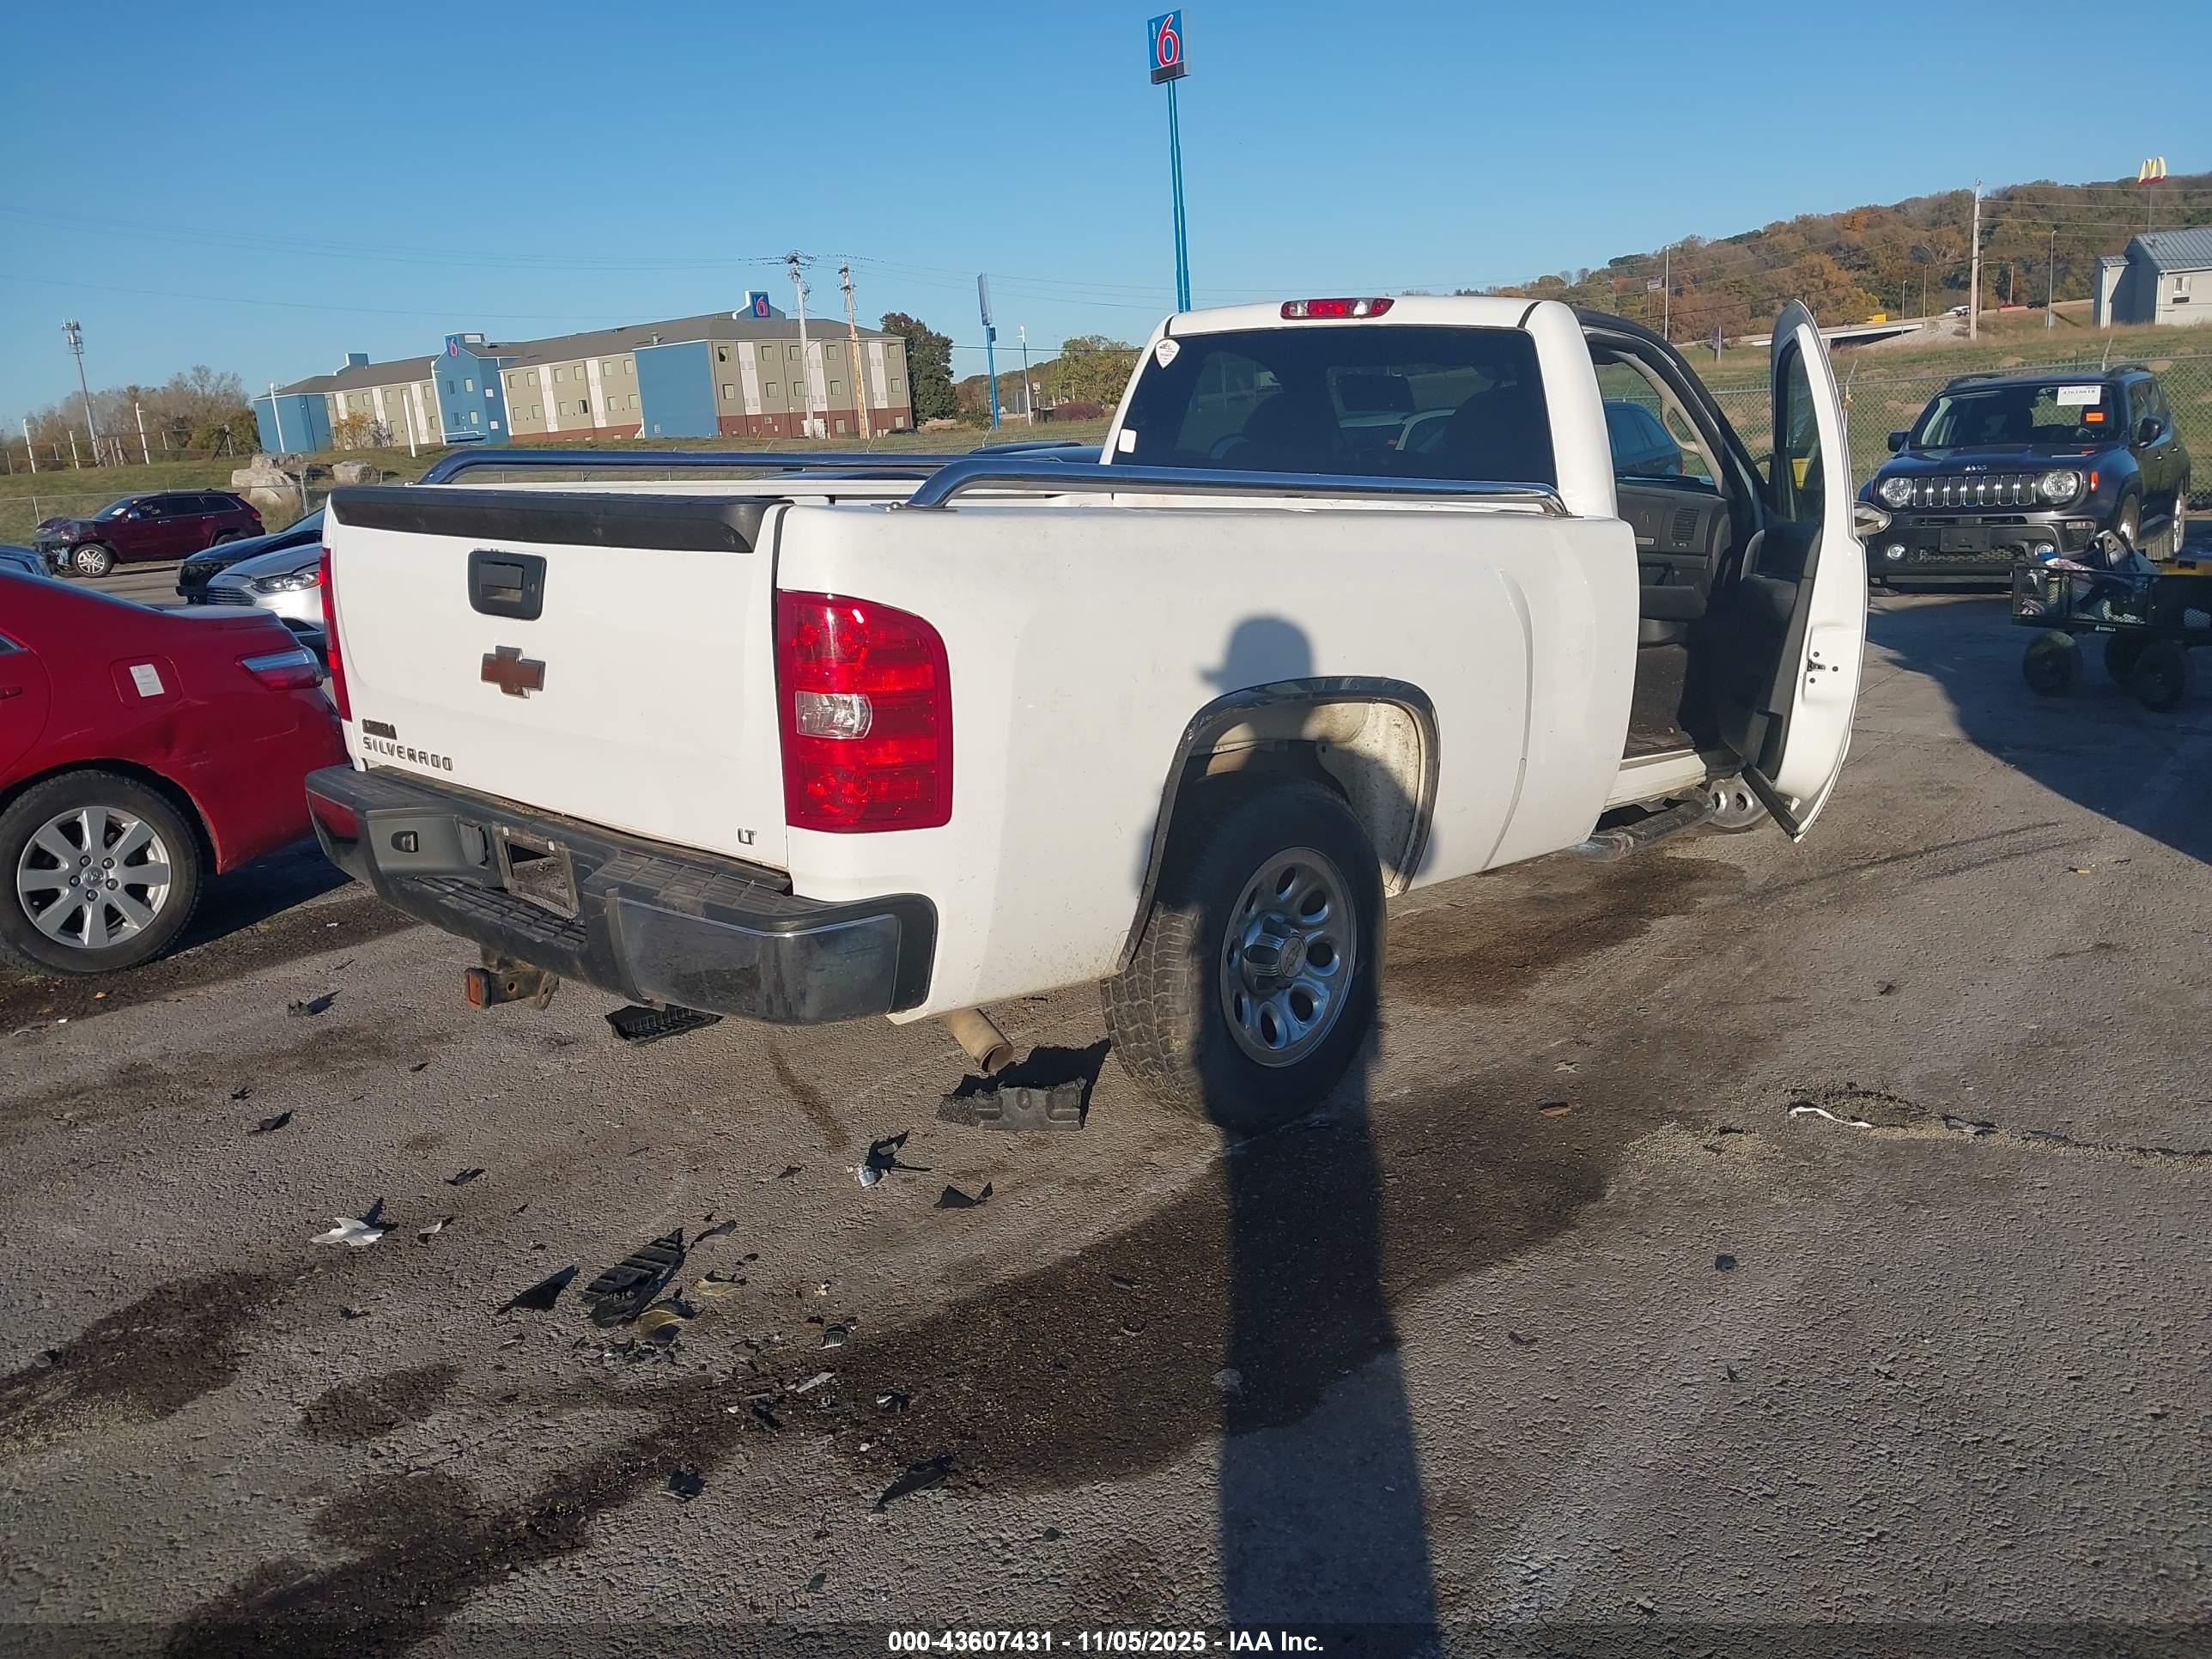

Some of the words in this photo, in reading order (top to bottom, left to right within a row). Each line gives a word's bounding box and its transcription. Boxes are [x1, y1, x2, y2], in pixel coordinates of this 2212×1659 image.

[1157, 14, 1180, 67] 6
[362, 736, 453, 772] SILVERADO
[738, 828, 757, 846] LT
